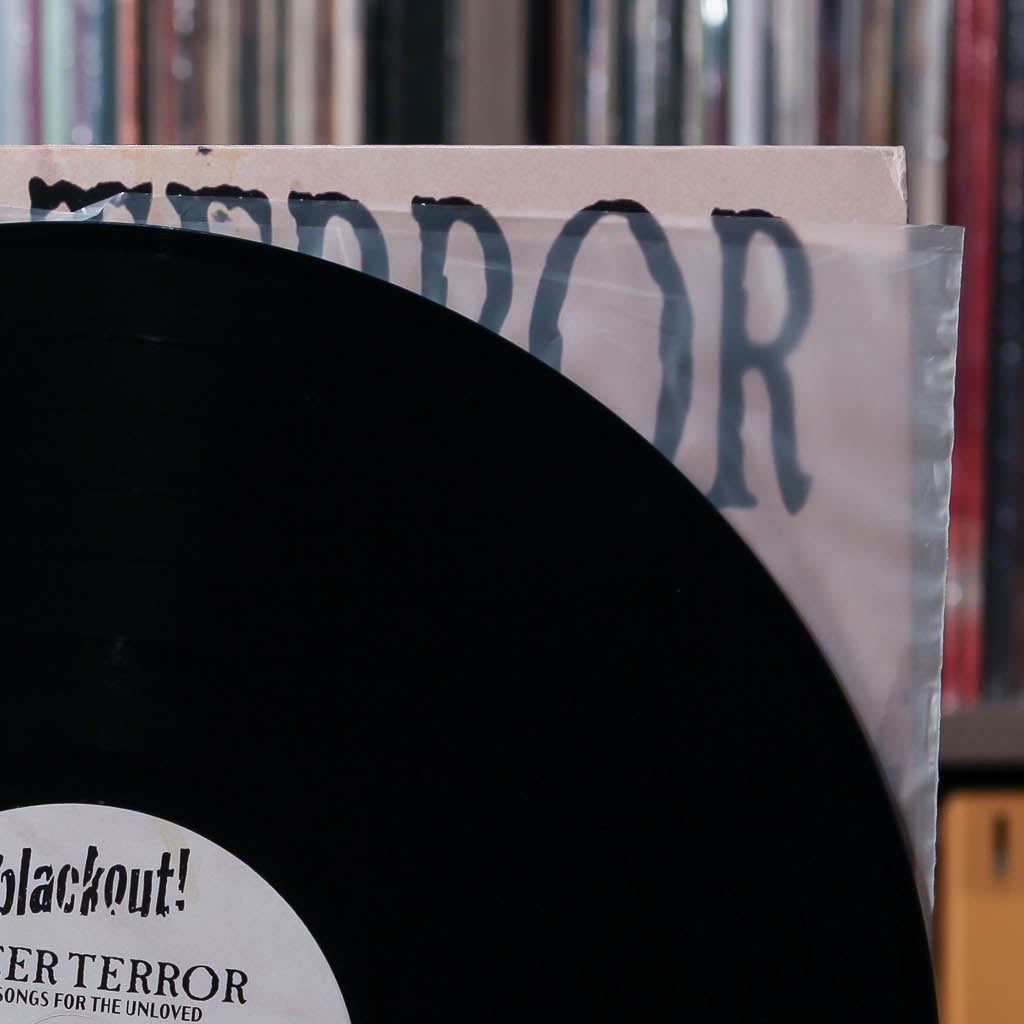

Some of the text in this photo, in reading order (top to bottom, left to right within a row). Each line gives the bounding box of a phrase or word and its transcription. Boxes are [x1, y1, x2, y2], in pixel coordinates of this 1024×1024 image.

[69, 952, 248, 1004] TERROR
[54, 992, 86, 1010] FOR
[91, 996, 121, 1014] THE
[126, 999, 202, 1022] UNLOVED
